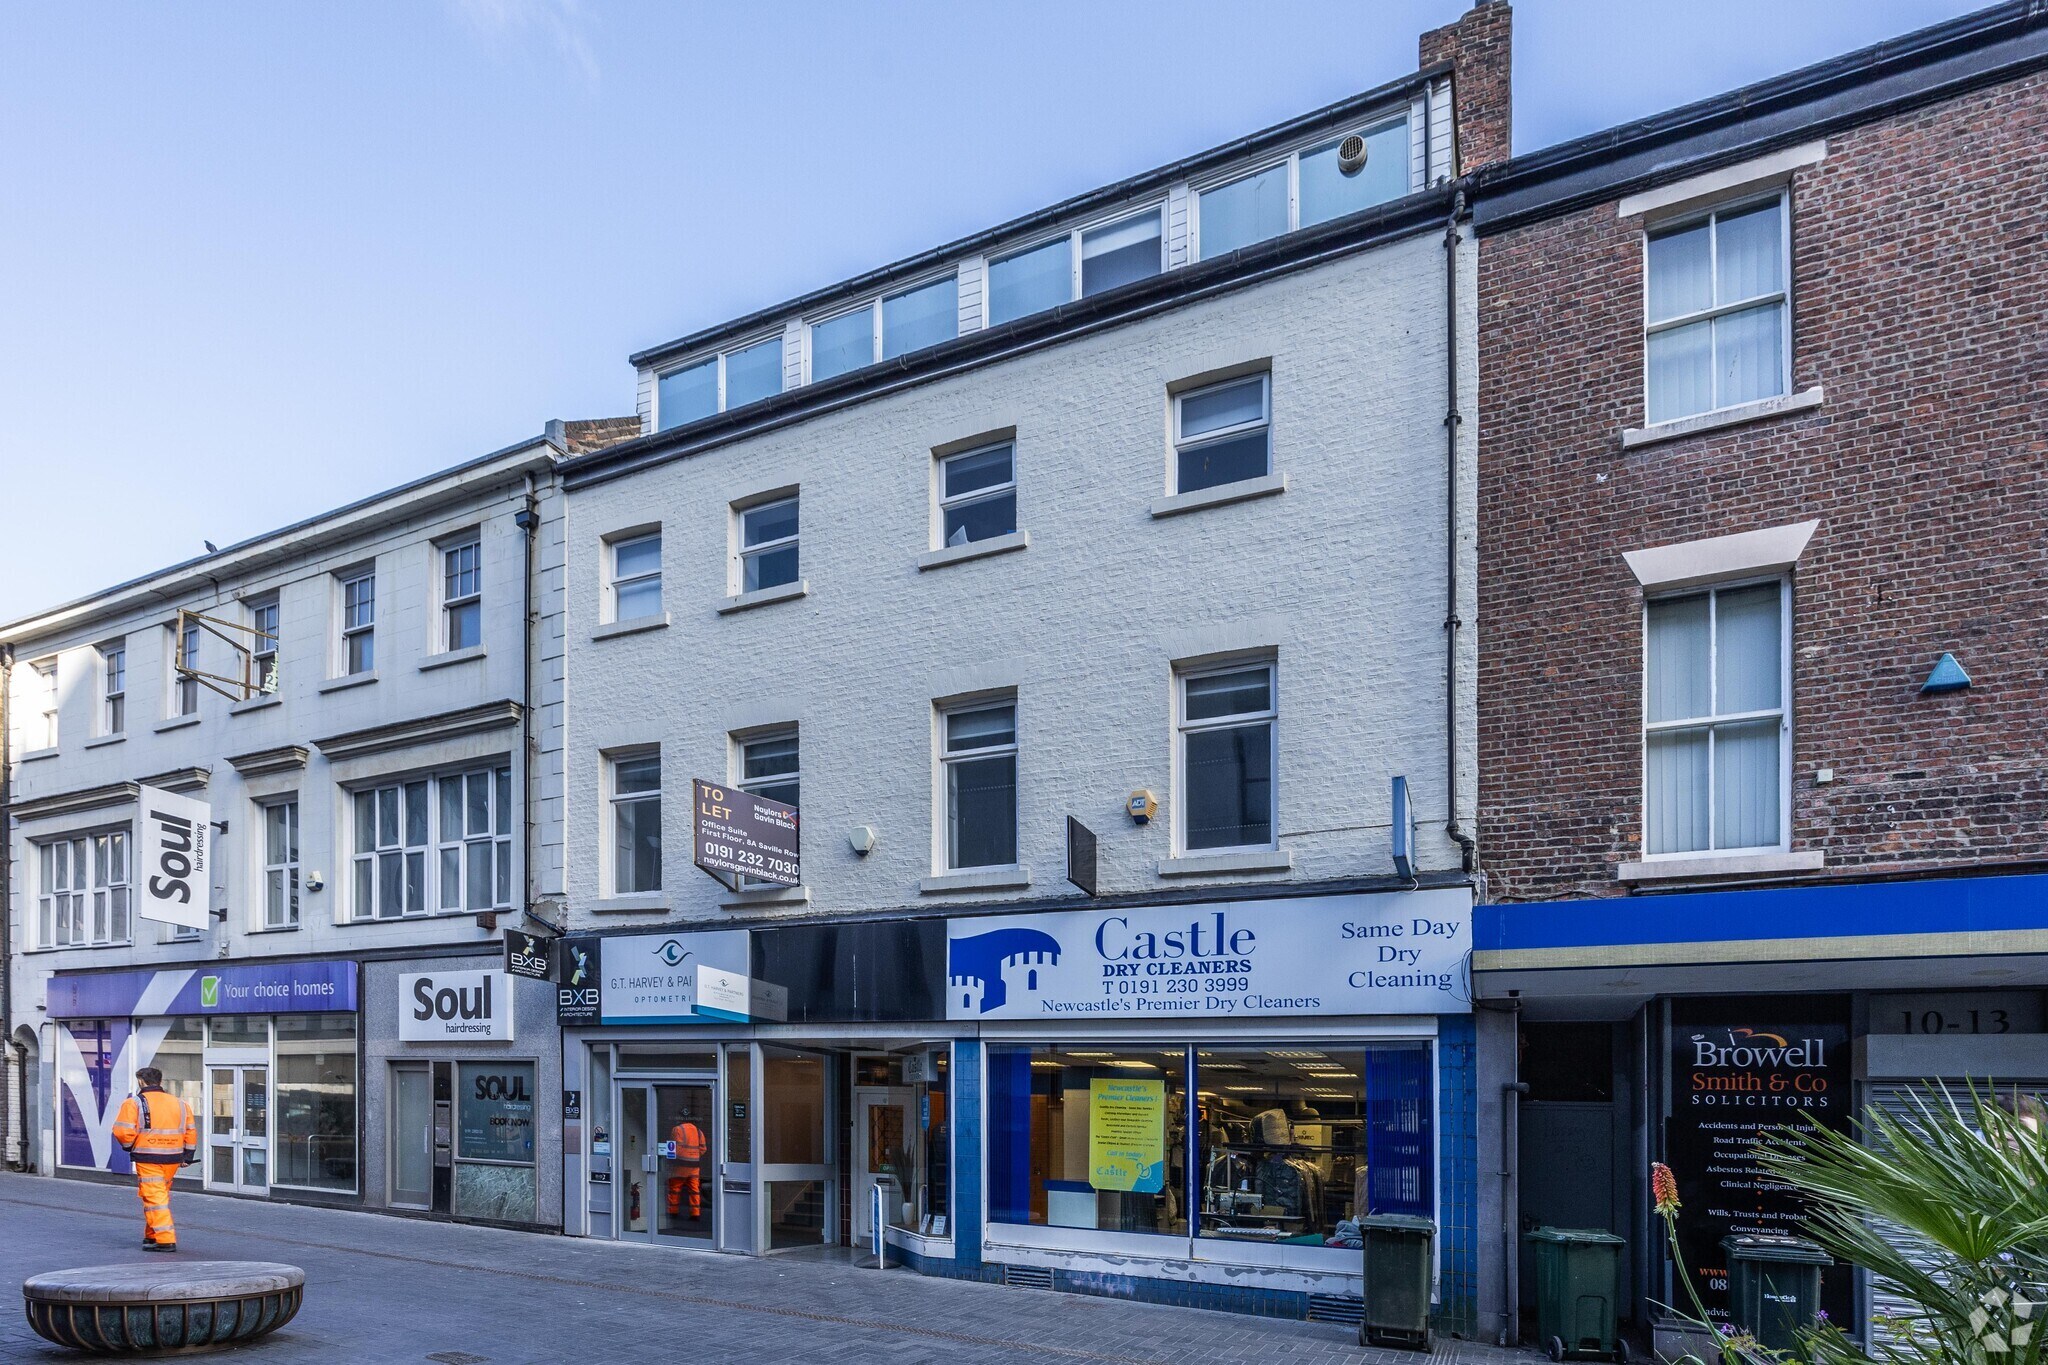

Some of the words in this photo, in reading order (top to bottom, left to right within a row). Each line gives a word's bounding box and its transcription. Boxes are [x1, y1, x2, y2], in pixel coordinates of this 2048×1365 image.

[702, 785, 724, 802] TO
[702, 802, 732, 820] LET
[753, 804, 782, 818] Naylors
[1132, 799, 1145, 807] ADT
[701, 819, 726, 832] Office
[728, 825, 748, 837] Suite
[754, 812, 775, 824] Gavin
[775, 819, 796, 831] Black
[194, 822, 206, 873] hairdressing
[701, 827, 721, 839] First
[722, 832, 745, 845] Floor,
[746, 838, 757, 848] 8A
[758, 842, 782, 854] Saville
[783, 848, 798, 858] Row
[148, 809, 192, 904] Soul
[705, 842, 733, 860] 0191
[738, 850, 764, 867] 232
[767, 857, 799, 876] 7030
[703, 856, 799, 884] naylorsgavinblack.co.uk
[1095, 912, 1256, 961] Castle
[1341, 922, 1404, 939] Same
[1410, 919, 1460, 939] Day
[511, 952, 547, 971] BXB
[1377, 945, 1421, 966] Dry
[1102, 963, 1141, 977] DRY
[1146, 959, 1252, 976] CLEANERS
[224, 983, 249, 998] Your
[253, 981, 290, 998] choice
[294, 979, 335, 997] homes
[611, 978, 627, 989] G.T.
[629, 976, 664, 989] HARVEY
[667, 976, 674, 988] &
[1102, 981, 1114, 995] T
[1119, 980, 1159, 994] 0191
[1166, 979, 1198, 993] 230
[1204, 977, 1249, 992] 3999
[1348, 969, 1453, 991] Cleaning
[413, 975, 492, 1021] Soul
[559, 988, 600, 1006] BXB
[1041, 998, 1131, 1013] Newcastle's
[1136, 996, 1200, 1011] Premier
[1205, 996, 1237, 1013] Dry
[1243, 994, 1321, 1009] Cleaners
[445, 1022, 491, 1036] hairdressing
[1692, 1038, 1828, 1068] Browell
[475, 1075, 531, 1102] SOUL
[1692, 1071, 1762, 1091] Smith
[1769, 1073, 1789, 1091] &
[1794, 1073, 1828, 1092] Co
[1691, 1094, 1828, 1107] SOLICITORS
[489, 1118, 510, 1126] BOOK
[510, 1118, 530, 1127] NOW
[1736, 1137, 1763, 1145] Traffic
[1765, 1138, 1806, 1146] Accdents
[1713, 1151, 1767, 1159] Occupationl
[1706, 1165, 1743, 1173] Asbestos
[1708, 1209, 1731, 1217] Wills,
[1733, 1210, 1759, 1218] Trusts
[1761, 1211, 1777, 1219] and
[1780, 1212, 1811, 1220] Probat
[1730, 1225, 1788, 1235] Conveyancing
[1705, 1308, 1730, 1317] advic
